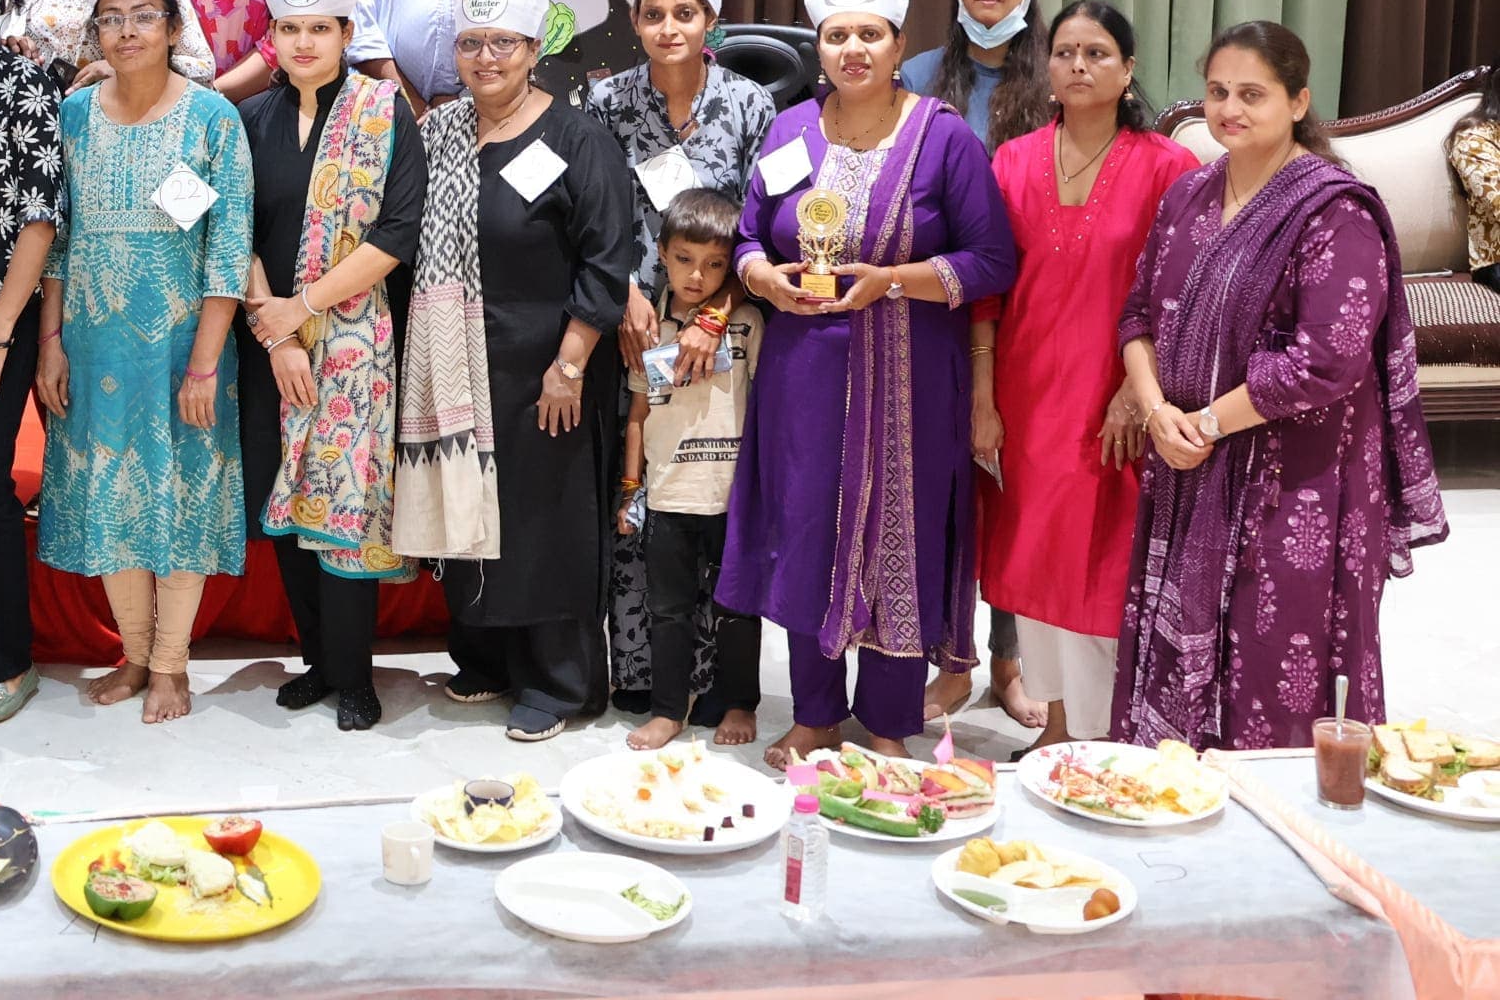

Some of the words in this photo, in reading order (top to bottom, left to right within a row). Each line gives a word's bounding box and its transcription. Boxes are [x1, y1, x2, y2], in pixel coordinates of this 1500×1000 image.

[470, 0, 501, 8] Master
[472, 7, 494, 19] Chef
[171, 179, 202, 201] 22
[683, 440, 731, 450] PREMIUM
